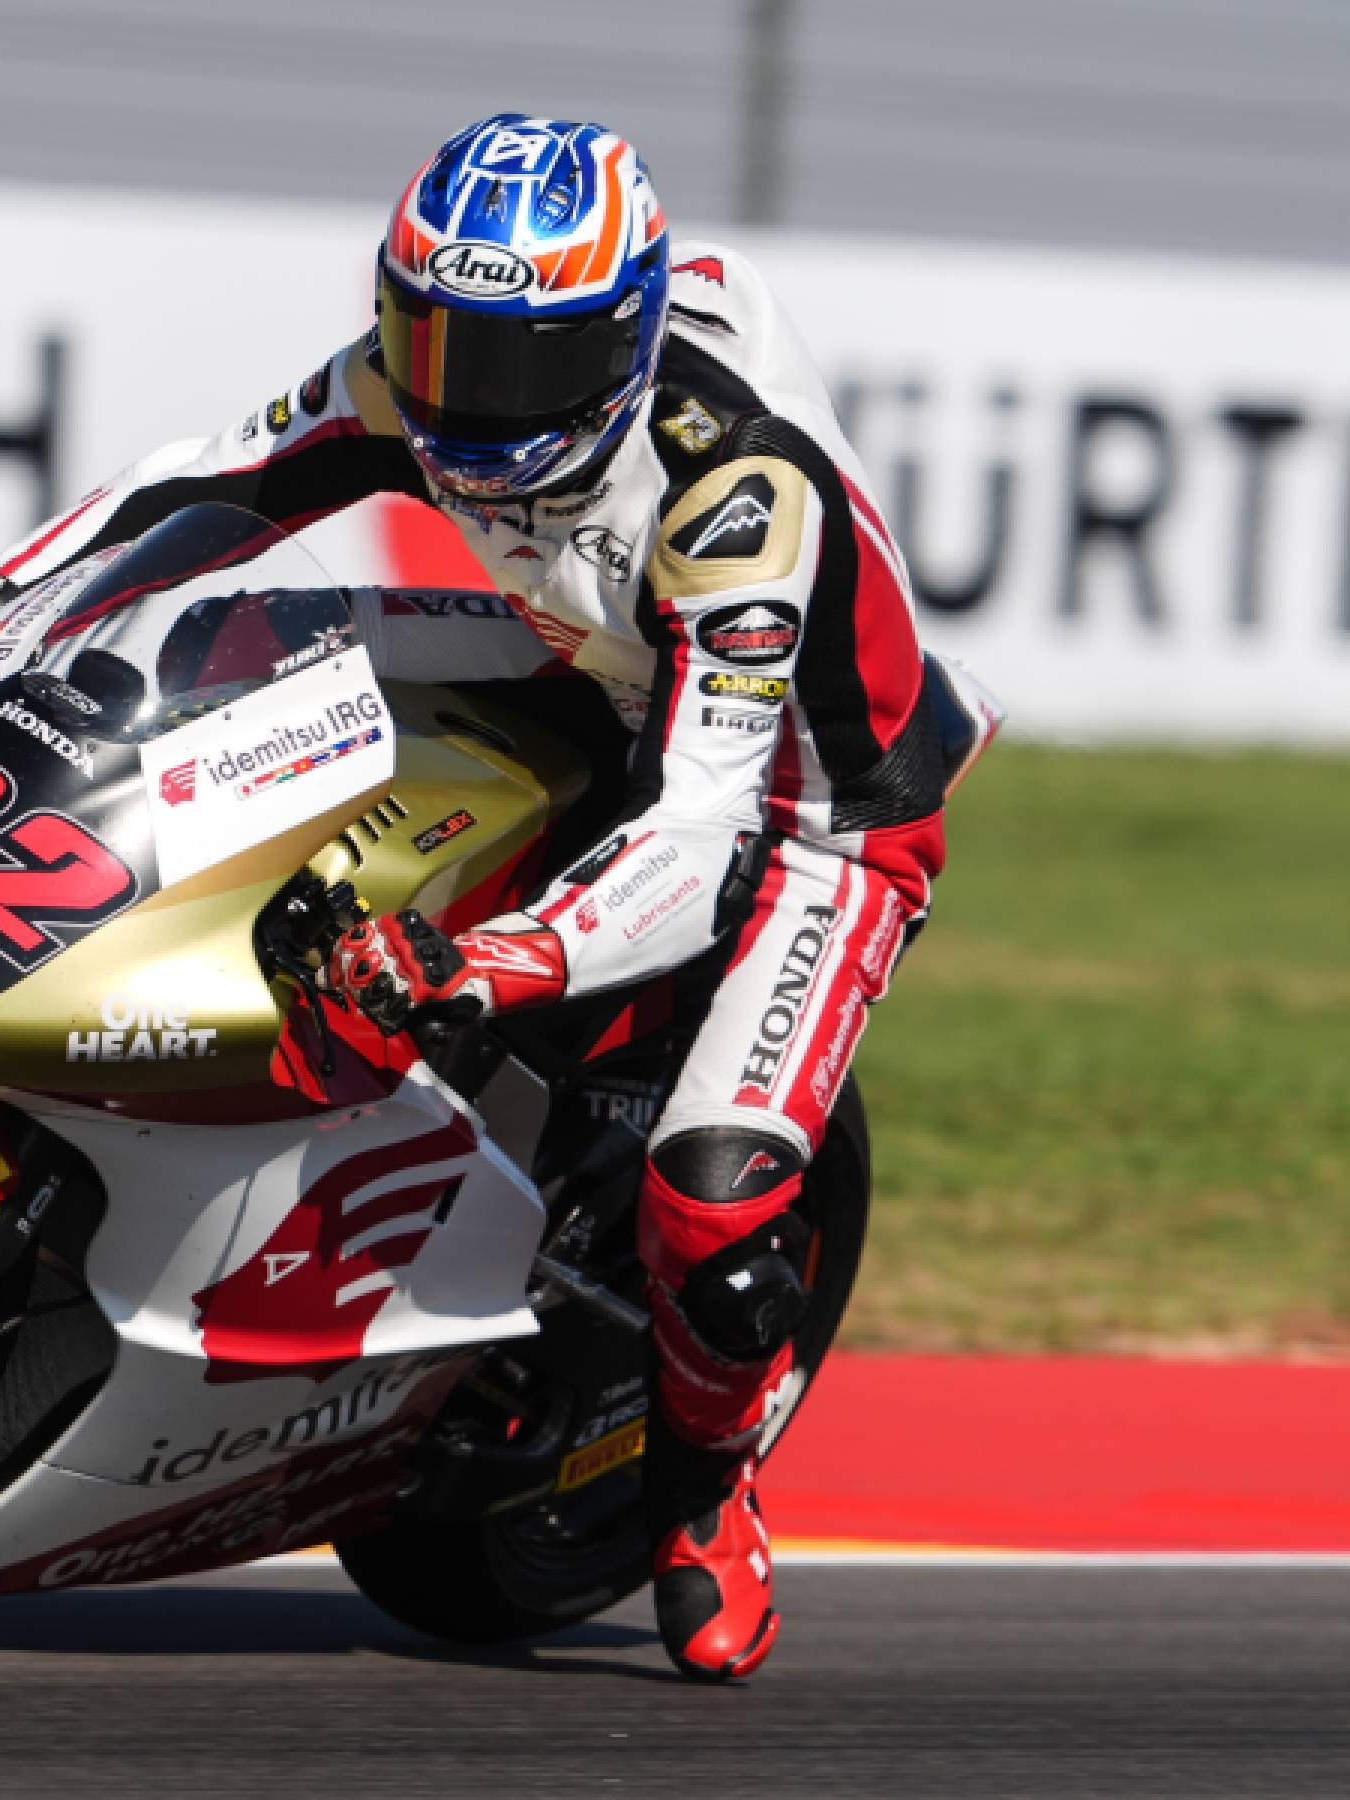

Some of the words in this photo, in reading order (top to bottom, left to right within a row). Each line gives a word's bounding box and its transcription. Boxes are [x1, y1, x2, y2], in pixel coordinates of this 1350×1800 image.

[447, 248, 519, 284] Arai
[838, 372, 1350, 640] ÜRT
[201, 721, 329, 787] idemitsu
[325, 692, 383, 738] IRG
[599, 845, 679, 912] idemitsu
[622, 874, 702, 941] Lubricants
[100, 992, 189, 1031] One
[742, 905, 839, 1089] HONDA
